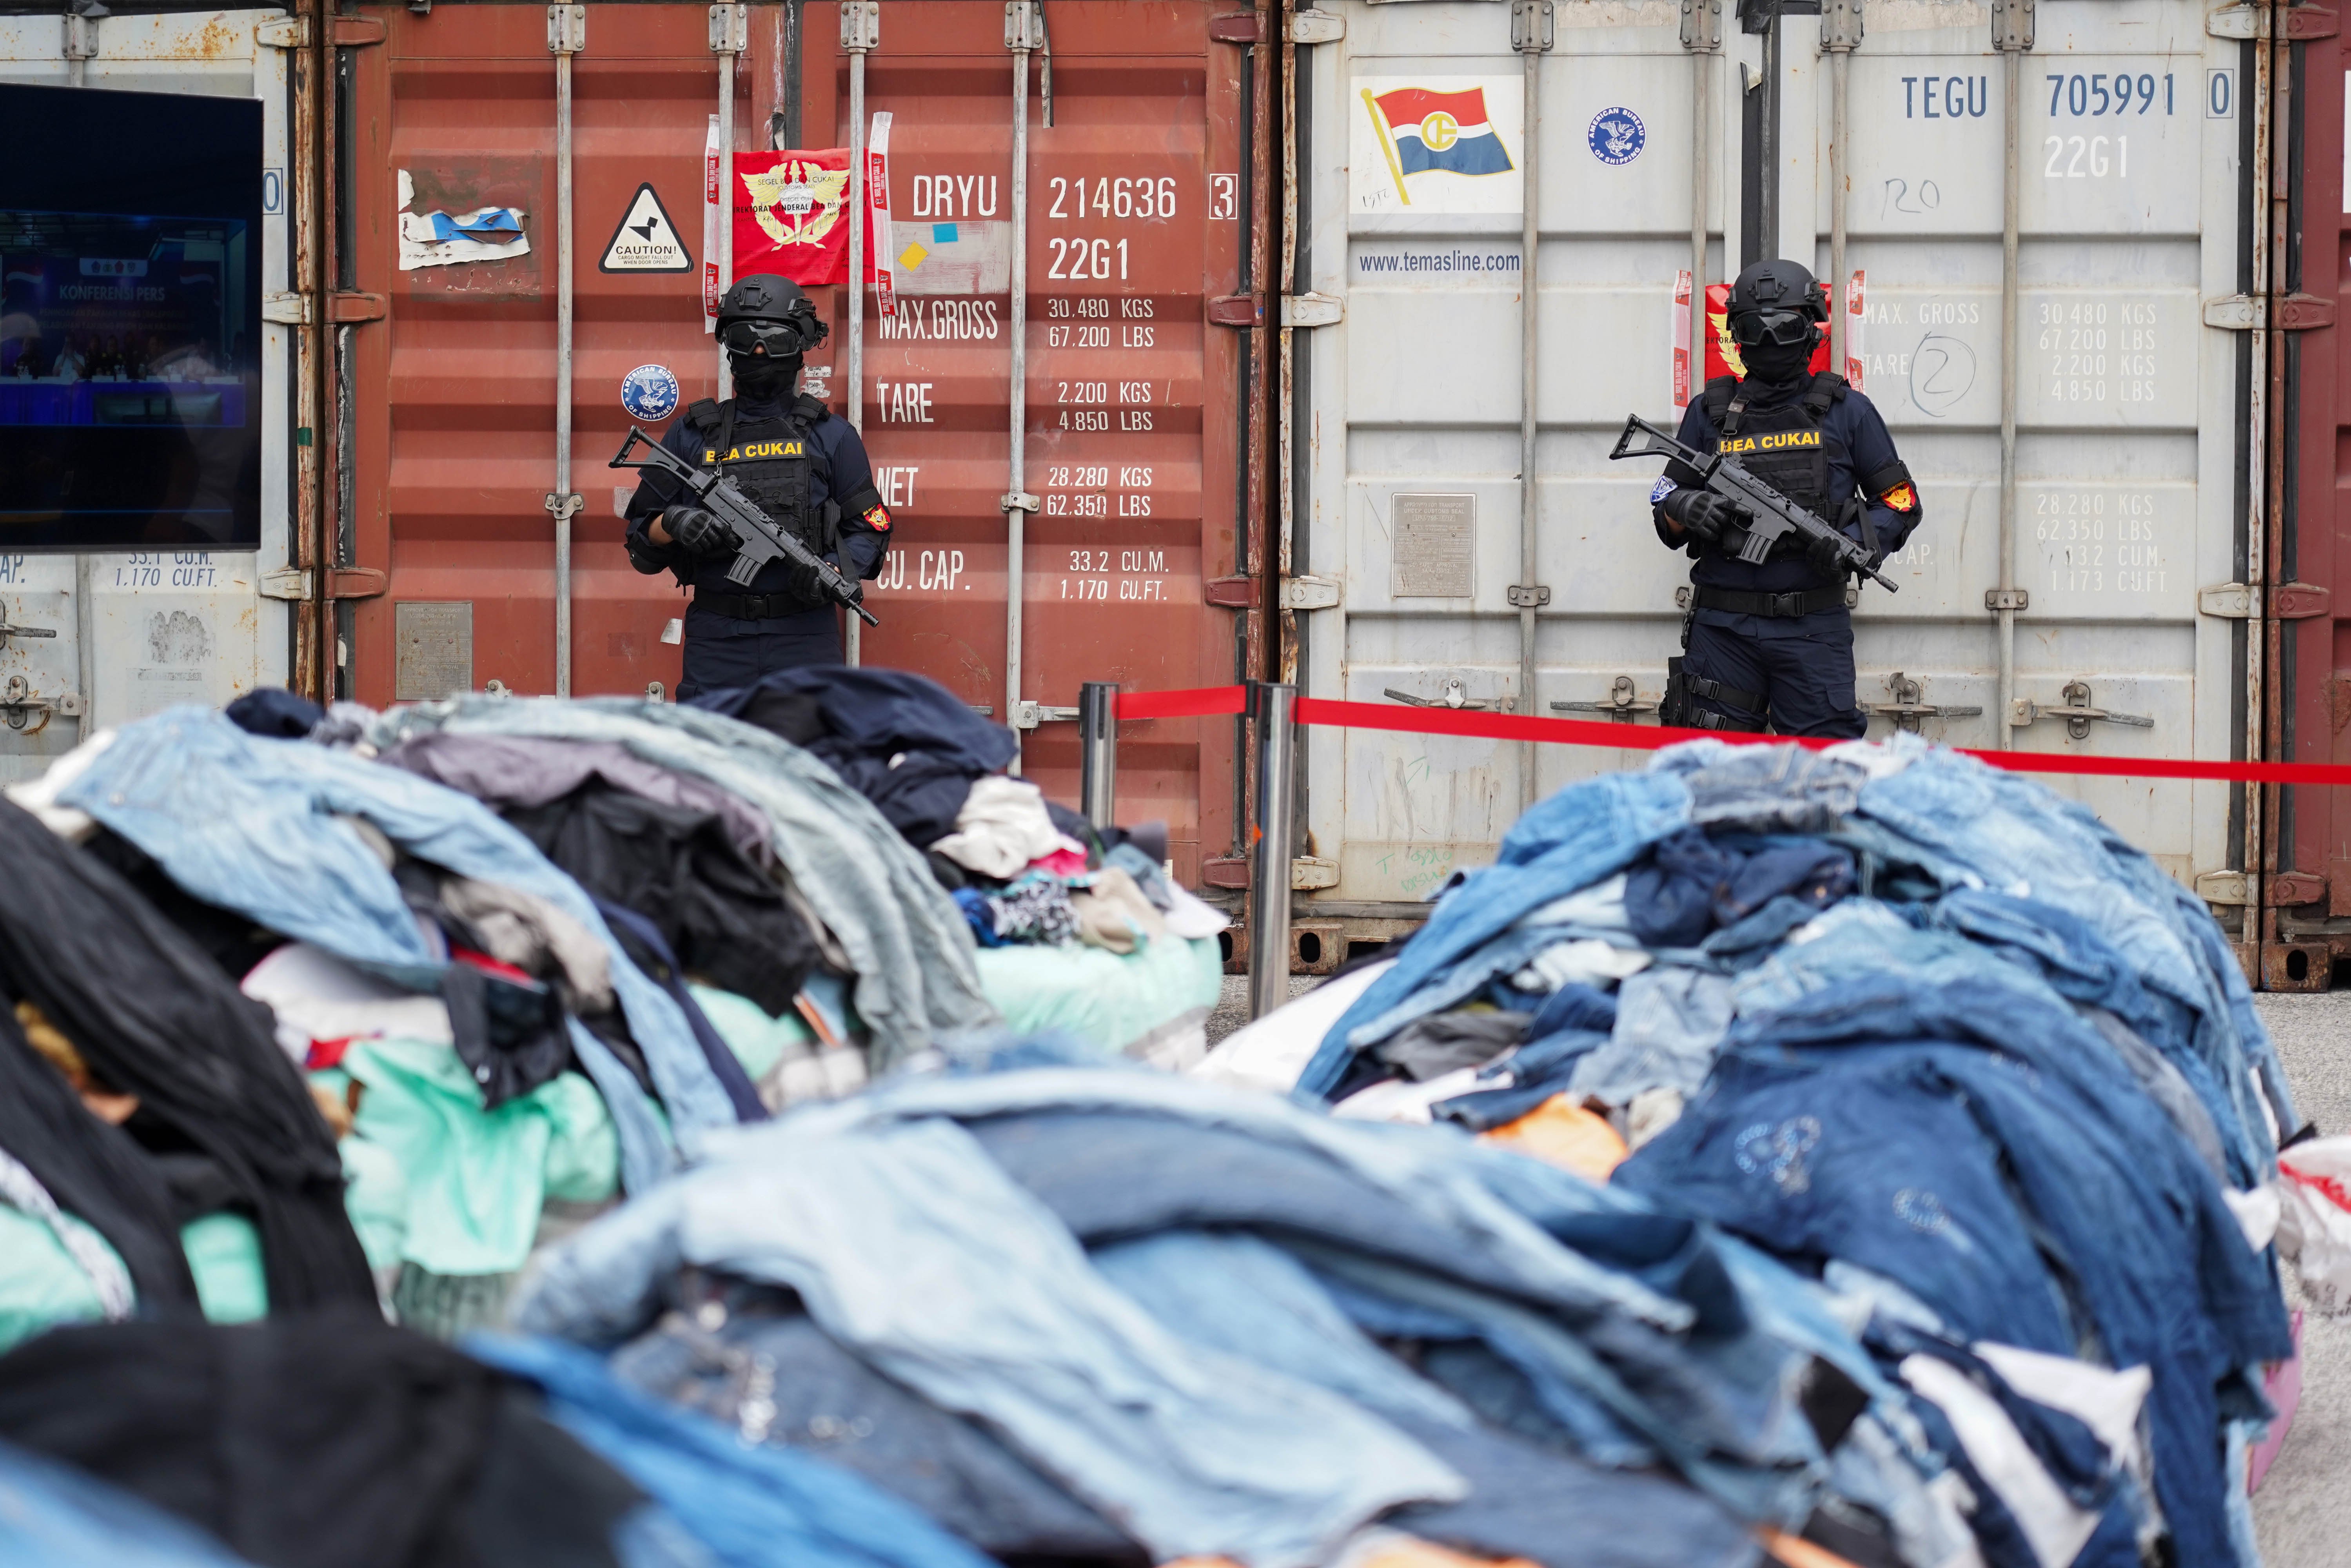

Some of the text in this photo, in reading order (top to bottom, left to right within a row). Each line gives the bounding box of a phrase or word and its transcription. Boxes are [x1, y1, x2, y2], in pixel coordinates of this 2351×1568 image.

[1902, 73, 2229, 118] TEGU 705991 0
[1589, 108, 1644, 138] AMERICAN BUREAU
[1595, 147, 1641, 164] OF SHIPPING
[2045, 135, 2127, 178] 22G1
[263, 172, 279, 211] 0
[913, 175, 1233, 218] DRYU 214636 3
[733, 205, 772, 214] IREKTORAT
[775, 204, 808, 212] JENDERAL
[1049, 238, 1127, 279] 22G1
[1360, 250, 1519, 271] www.temasline.com
[60, 285, 165, 301] KONFERENSI PERS
[1122, 299, 1153, 317] KGS
[1865, 303, 1909, 324] MAX.
[1919, 303, 1979, 324] GROSS
[2122, 303, 2155, 324] KGS
[1124, 327, 1153, 347] LBS
[2122, 329, 2155, 350] LBS
[1864, 354, 1909, 375] TARE
[2121, 355, 2155, 376] KGS
[1924, 348, 1953, 394] 2
[624, 367, 676, 394] AMERICAN BUREAU
[2121, 381, 2154, 401] LBS
[639, 405, 672, 419] SHIPPING
[877, 383, 934, 422] TARE
[1120, 382, 1151, 403] KGS
[1121, 412, 1152, 430] LBS
[745, 443, 802, 457] CUKAI
[1720, 432, 1819, 453] BEA CUKAI
[877, 467, 919, 506] NET
[1120, 467, 1152, 486] KGS
[1120, 495, 1150, 516] LBS
[2119, 494, 2153, 515] KGS
[2119, 520, 2152, 541] LBS
[2065, 545, 2103, 566] 33.2
[2119, 545, 2162, 566] CU.M.
[117, 568, 215, 586] 1,170 CU.FT.
[920, 551, 970, 590] CAP.
[1070, 551, 1108, 571] 33.2
[1122, 551, 1168, 572] CU.M.
[1120, 580, 1167, 600] CU.FT.
[2118, 571, 2166, 592] CU.FT.
